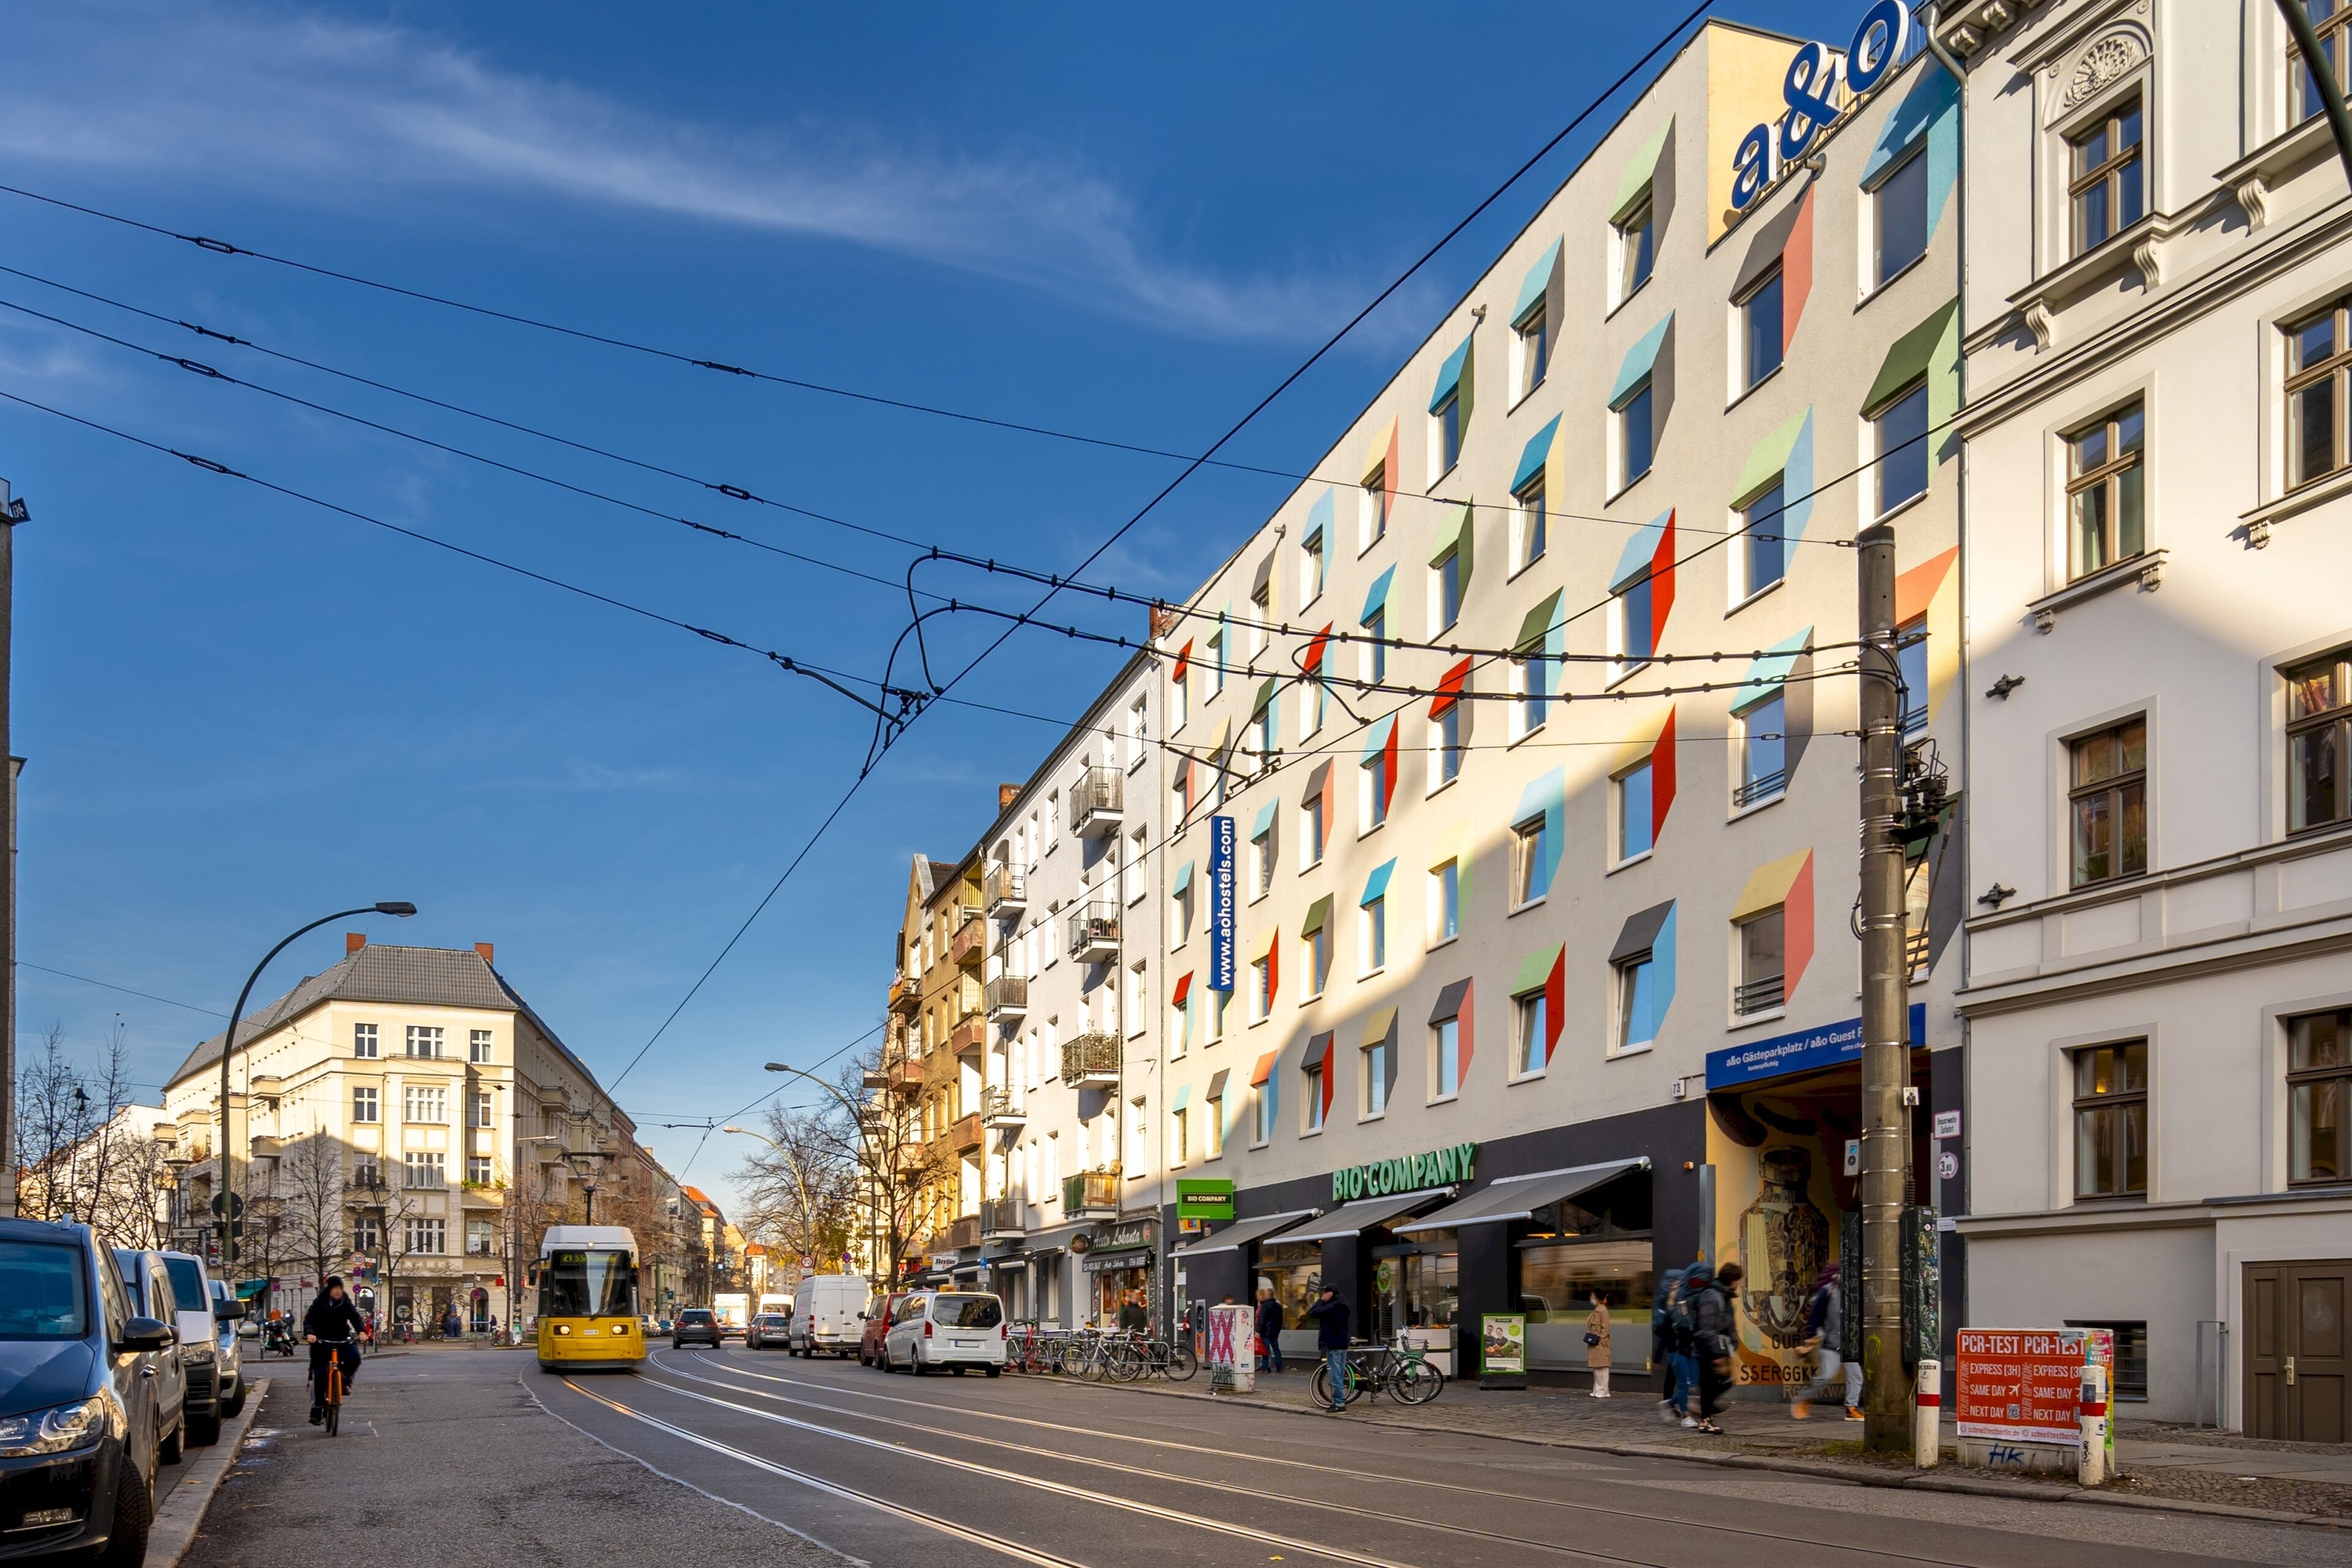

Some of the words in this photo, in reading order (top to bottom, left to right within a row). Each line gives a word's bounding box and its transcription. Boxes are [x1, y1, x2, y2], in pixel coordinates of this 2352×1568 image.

[1731, 0, 1909, 211] a&o
[1218, 820, 1231, 986] www.aohostels.com
[1726, 1055, 1741, 1067] a&o
[1743, 1042, 1803, 1063] Gästeparkplatz
[1810, 1036, 1827, 1049] a&o
[1829, 1031, 1855, 1044] Guest
[1673, 1083, 1680, 1094] 73
[1333, 1165, 1365, 1201] BIO
[1368, 1142, 1478, 1196] COMPANY
[1961, 1335, 2019, 1354] PCR-TEST
[2024, 1336, 2084, 1355] PCR-TEST
[1970, 1363, 2002, 1375] EXPRESS
[2004, 1365, 2021, 1377] (3H)
[2034, 1365, 2068, 1378] EXPRESS
[1970, 1384, 1990, 1396] SAME
[1992, 1385, 2006, 1396] DAY
[2034, 1387, 2055, 1399] SAME
[2057, 1387, 2073, 1400] DAY
[1959, 1394, 1969, 1417] YOUR
[1970, 1405, 1989, 1417] NEXT
[1990, 1406, 2005, 1418] DAY
[2022, 1397, 2032, 1420] YOUR
[2034, 1409, 2054, 1420] NEXT
[2056, 1410, 2071, 1422] DAY
[1989, 1443, 2024, 1464] HK
